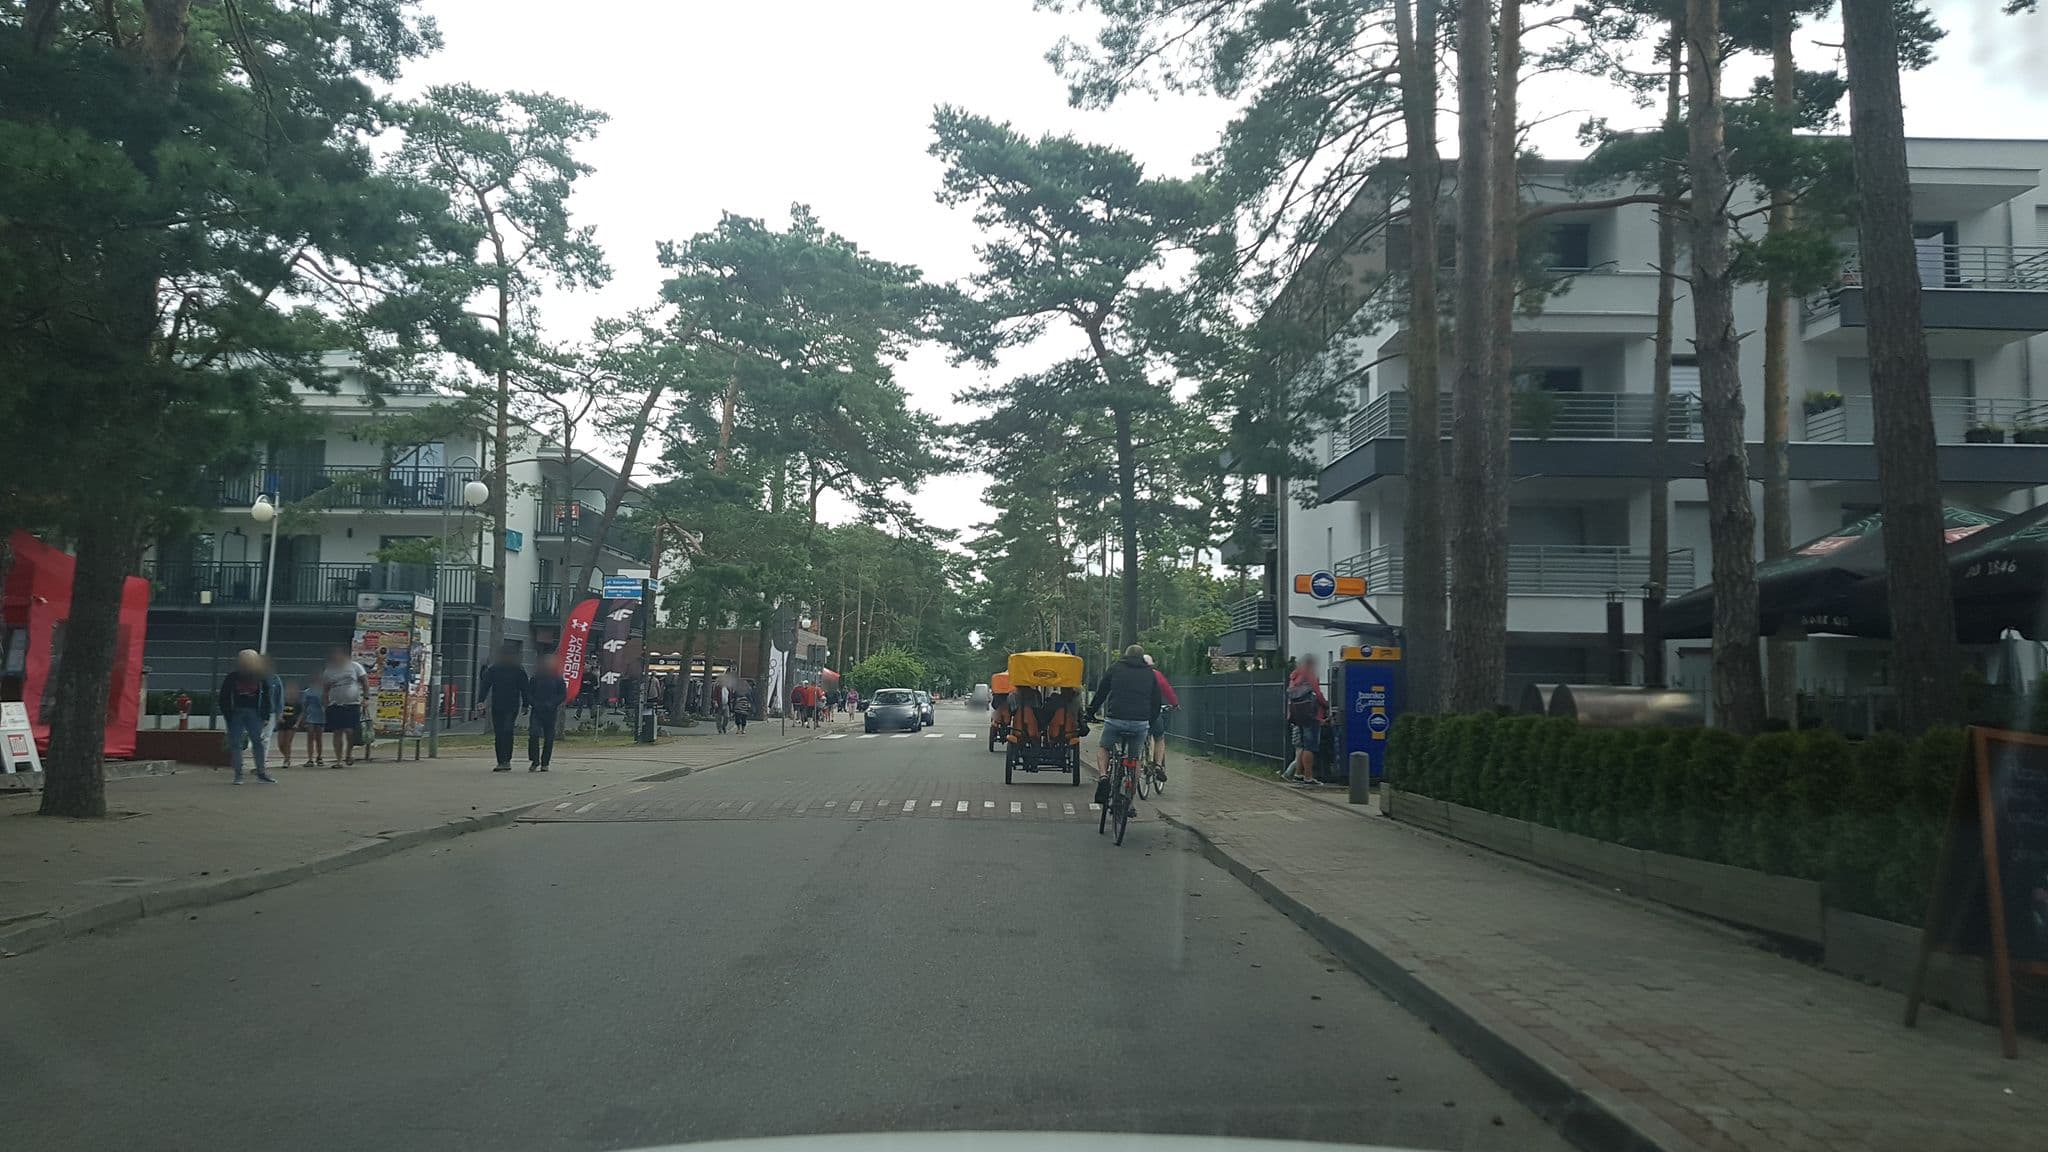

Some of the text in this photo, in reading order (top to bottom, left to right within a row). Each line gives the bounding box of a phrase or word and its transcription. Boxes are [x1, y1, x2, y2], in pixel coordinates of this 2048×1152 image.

[607, 609, 634, 621] 4F
[603, 639, 626, 652] 4F
[571, 637, 583, 679] UNDER
[601, 672, 620, 684] 4F
[1358, 691, 1385, 699] banko
